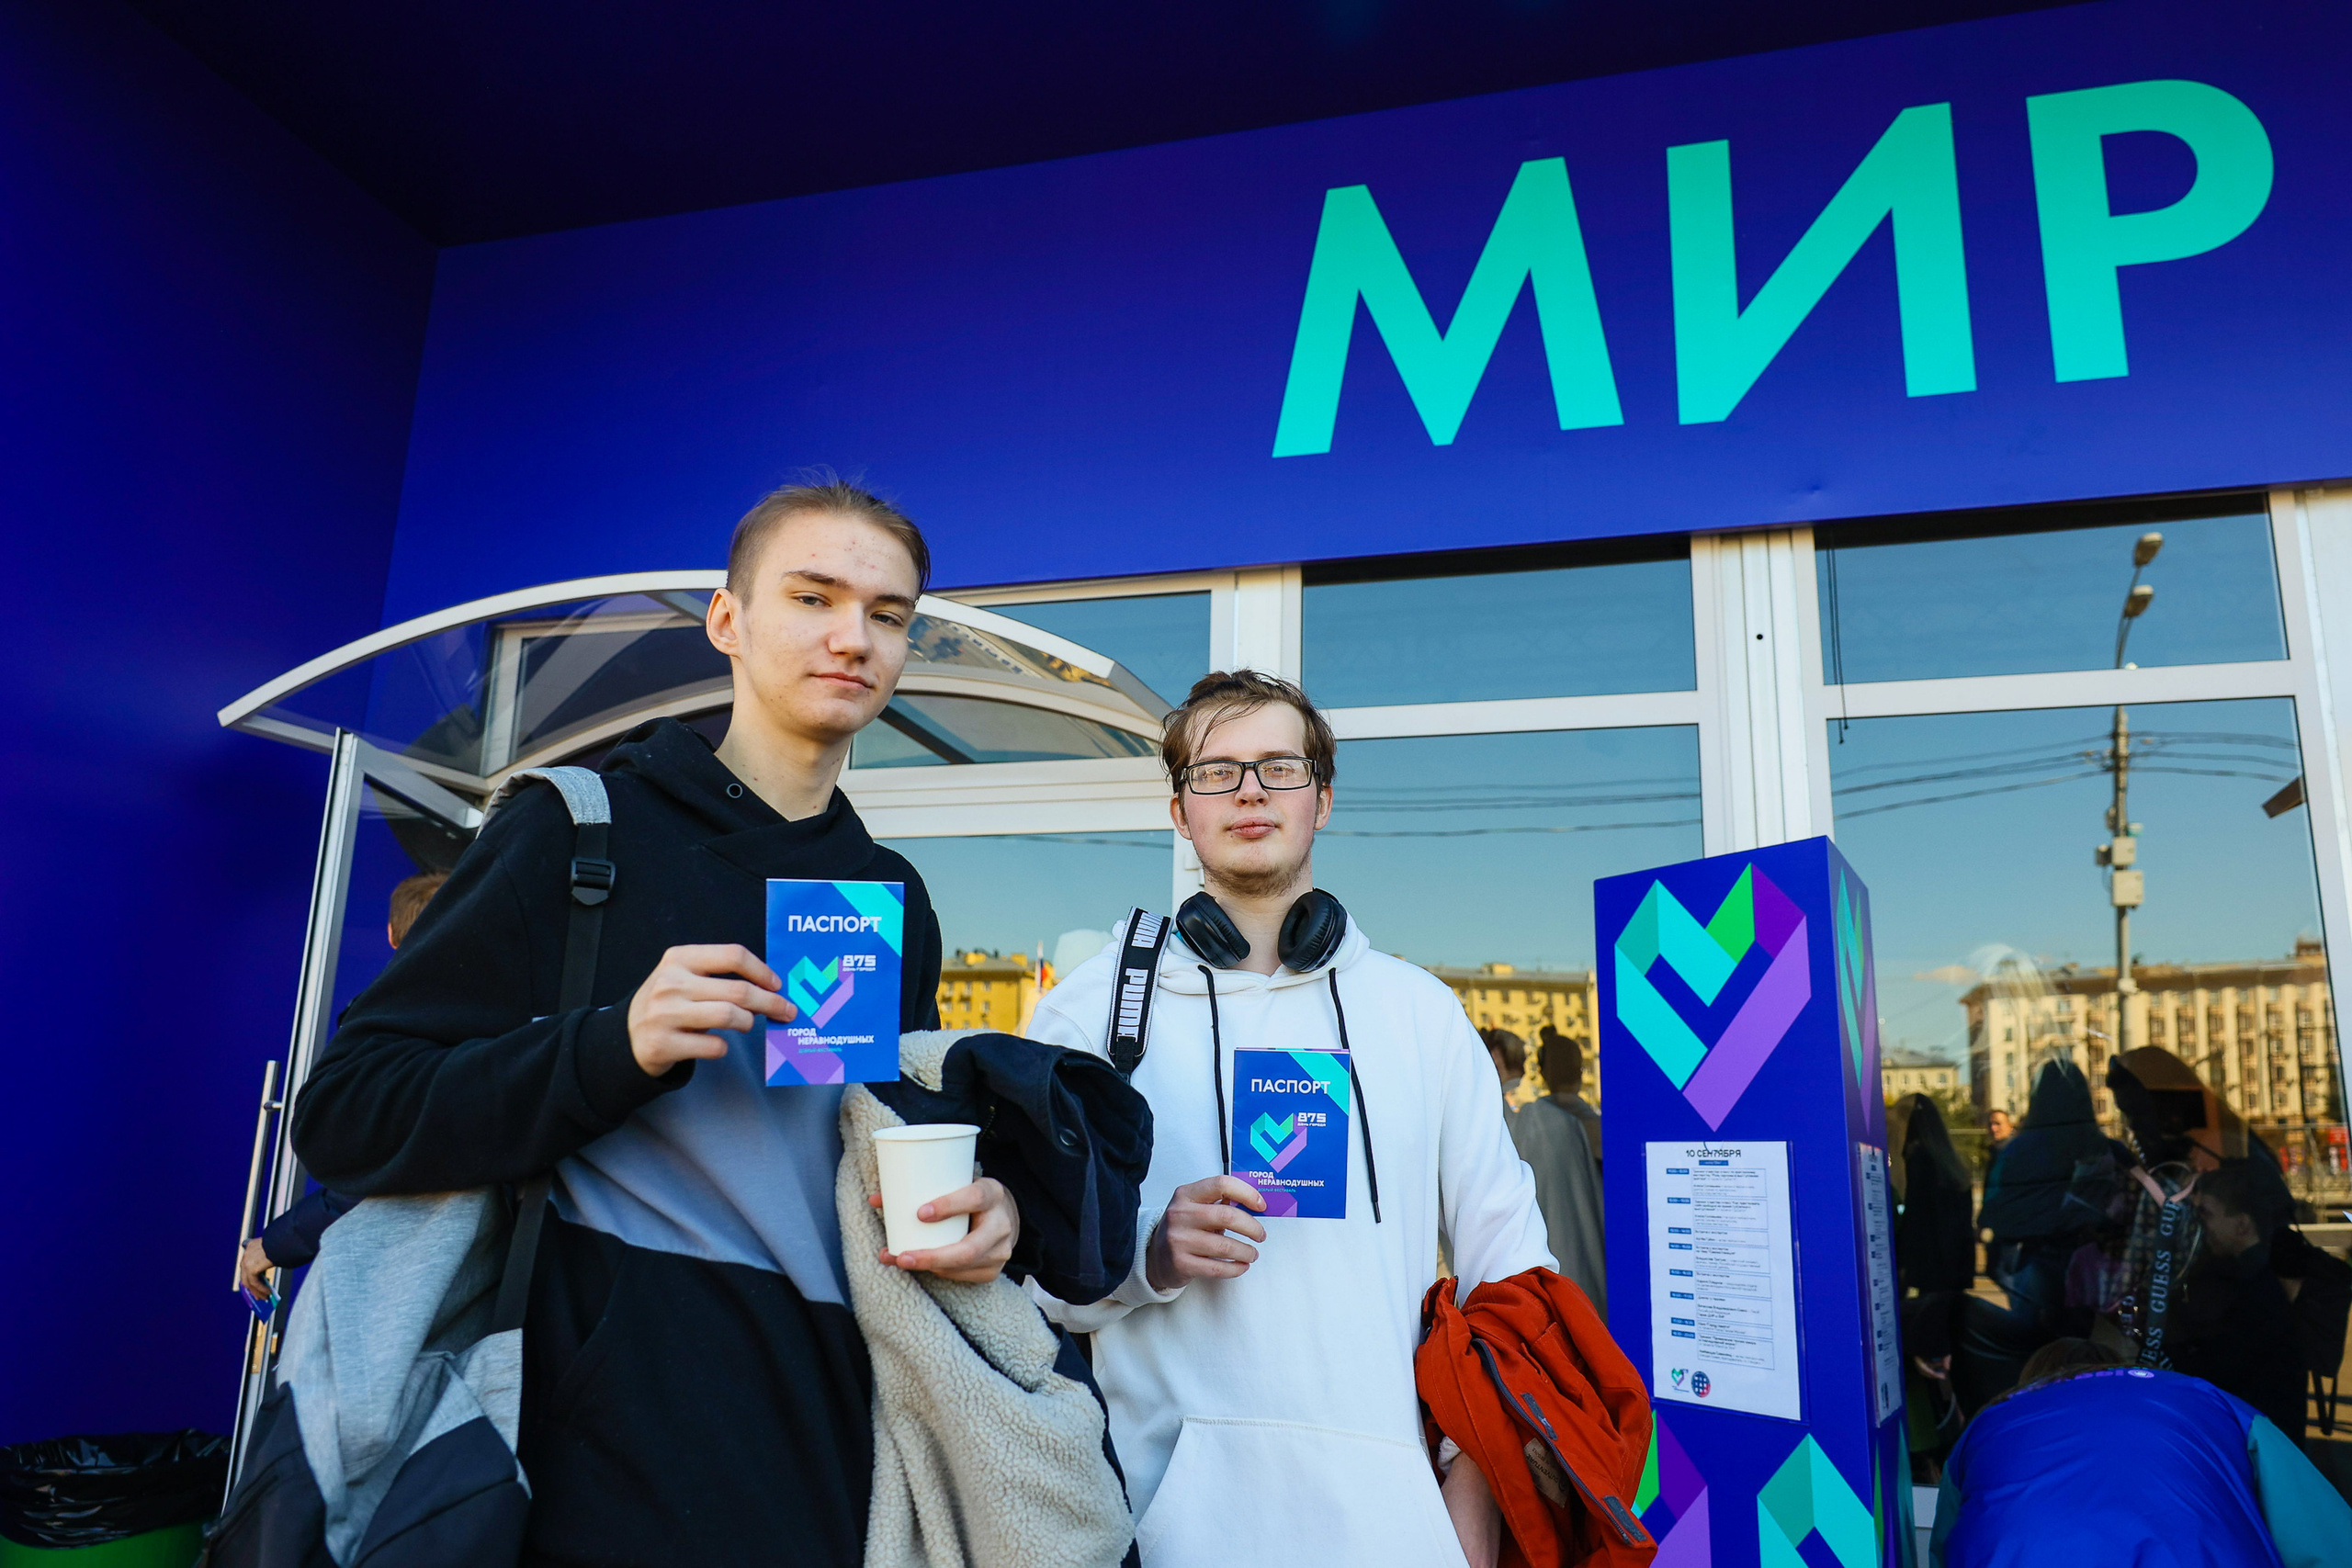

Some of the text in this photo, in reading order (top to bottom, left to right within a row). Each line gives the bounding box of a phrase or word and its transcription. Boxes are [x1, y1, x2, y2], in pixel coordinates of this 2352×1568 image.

[1272, 79, 2275, 458] МИР
[788, 915, 882, 933] ПАСПОРТ
[1131, 911, 1164, 948] UMA
[842, 955, 876, 967] 875
[787, 1028, 817, 1037] ГОРОД
[797, 1035, 874, 1045] НЕРАВНОДУШНЫХ
[1250, 1078, 1331, 1094] ПАСПОРТ
[1297, 1112, 1327, 1123] 875
[1686, 1149, 1741, 1157] 10 СЕНТЯБРЯ
[1258, 1179, 1325, 1187] НЕРАВНОДУШНЫХ
[2150, 1249, 2172, 1314] GUESS
